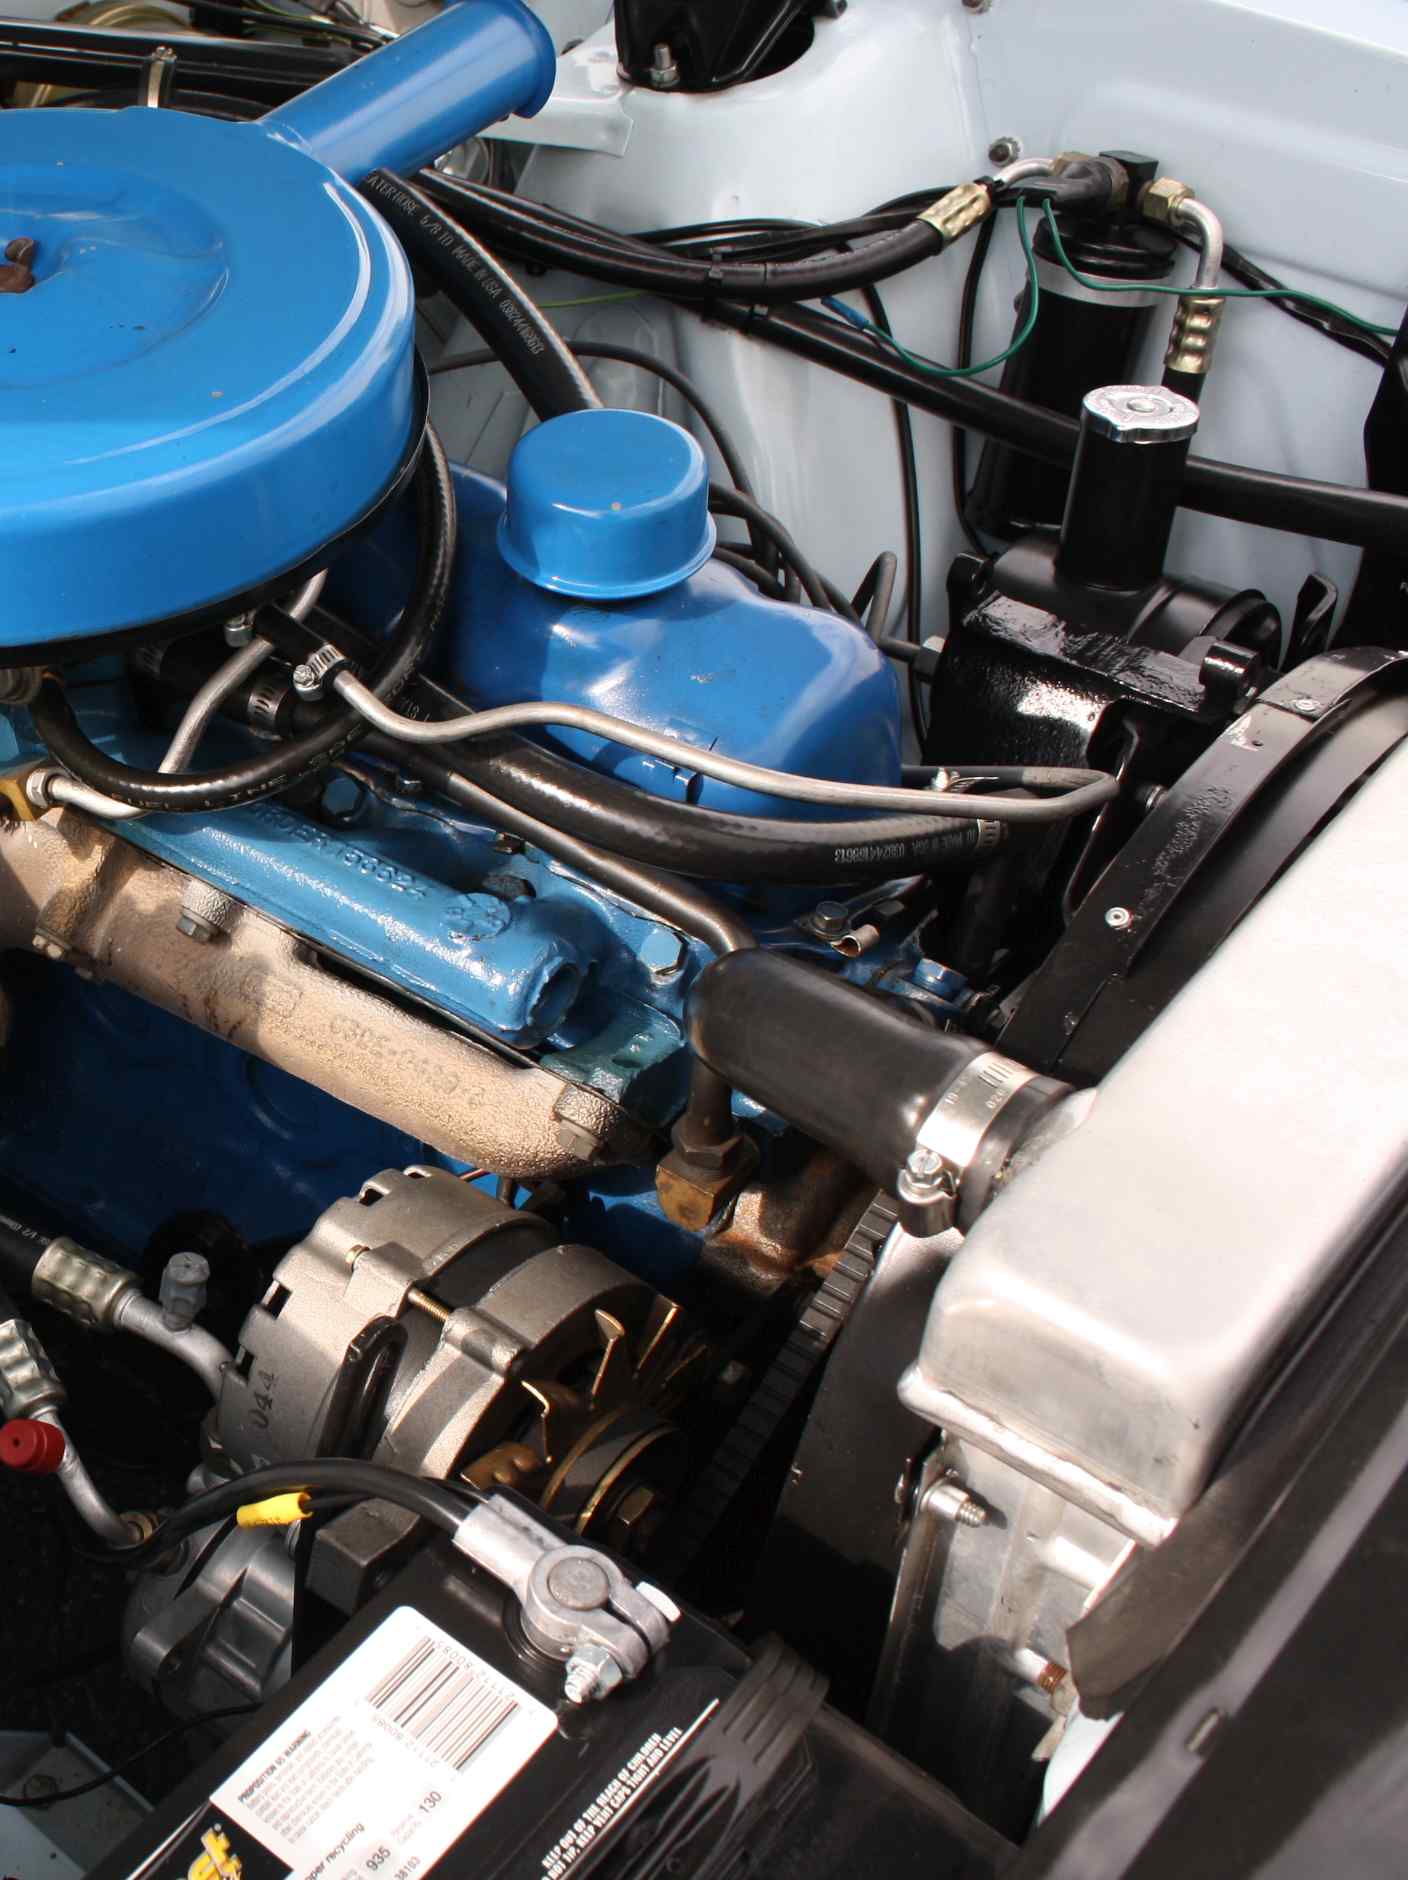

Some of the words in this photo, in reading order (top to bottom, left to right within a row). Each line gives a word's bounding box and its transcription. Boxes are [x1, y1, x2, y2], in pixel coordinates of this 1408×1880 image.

[451, 245, 477, 271] MADE
[481, 275, 503, 299] USA
[419, 1791, 442, 1814] 130
[541, 1845, 561, 1869] KEEP
[559, 1829, 577, 1850] OUT
[573, 1818, 587, 1833] OF
[582, 1803, 600, 1821] THE
[596, 1779, 622, 1806] REACH
[617, 1767, 631, 1781] OF
[626, 1732, 663, 1771] CHILDREN
[576, 1824, 597, 1848] KEEP
[592, 1804, 615, 1828] VENT
[609, 1786, 632, 1809] CAPS
[625, 1763, 651, 1788] TIGHT
[647, 1748, 664, 1768] AND
[660, 1727, 683, 1751] LEVEL
[325, 1822, 365, 1865] recycling
[365, 1845, 391, 1872] 935
